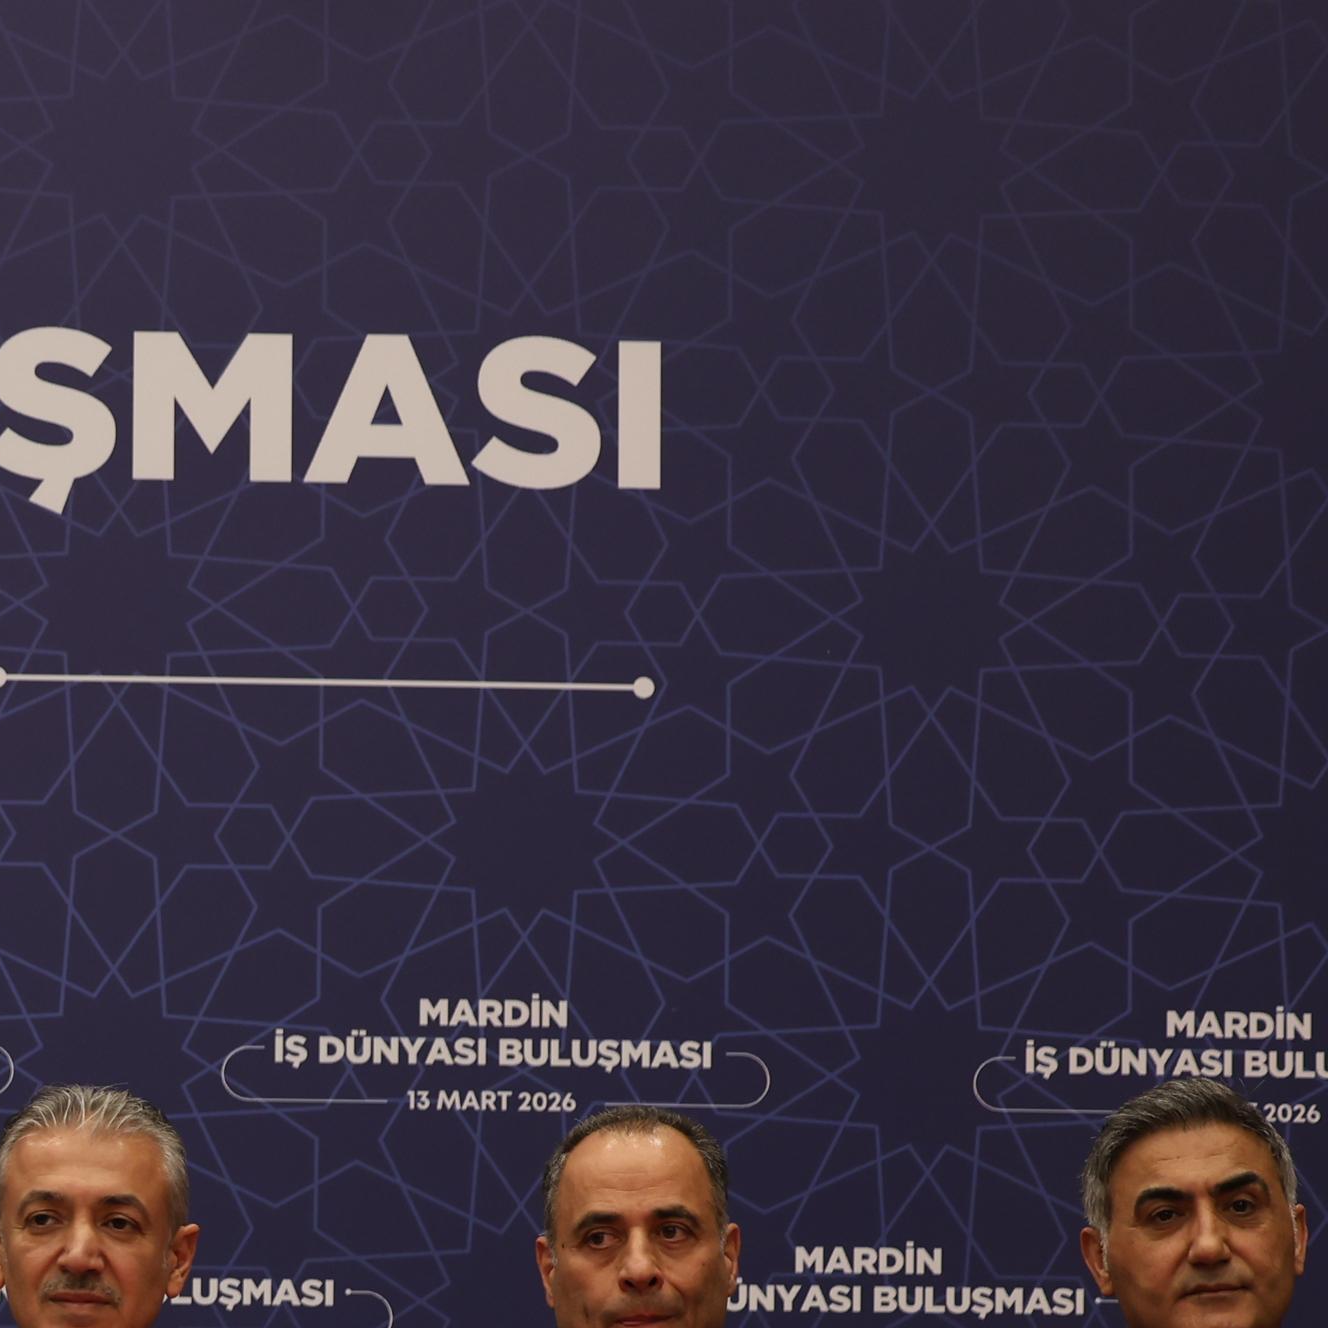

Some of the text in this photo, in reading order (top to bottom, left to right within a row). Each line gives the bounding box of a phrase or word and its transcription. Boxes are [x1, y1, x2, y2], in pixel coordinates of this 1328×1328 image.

[419, 993, 568, 1028] MARDİN
[1166, 1006, 1312, 1040] MARDİN
[274, 1028, 712, 1073] İŞ DÜNYASI BULUŞMASI
[1025, 1039, 1058, 1079] İŞ
[1069, 1040, 1233, 1077] DÜNYASI
[407, 1090, 577, 1112] 13 MART 2026
[1263, 1103, 1321, 1123] 2026
[795, 1241, 942, 1275] MARDİN
[726, 1277, 1085, 1319] ÜNYASI BULUŞMASI
